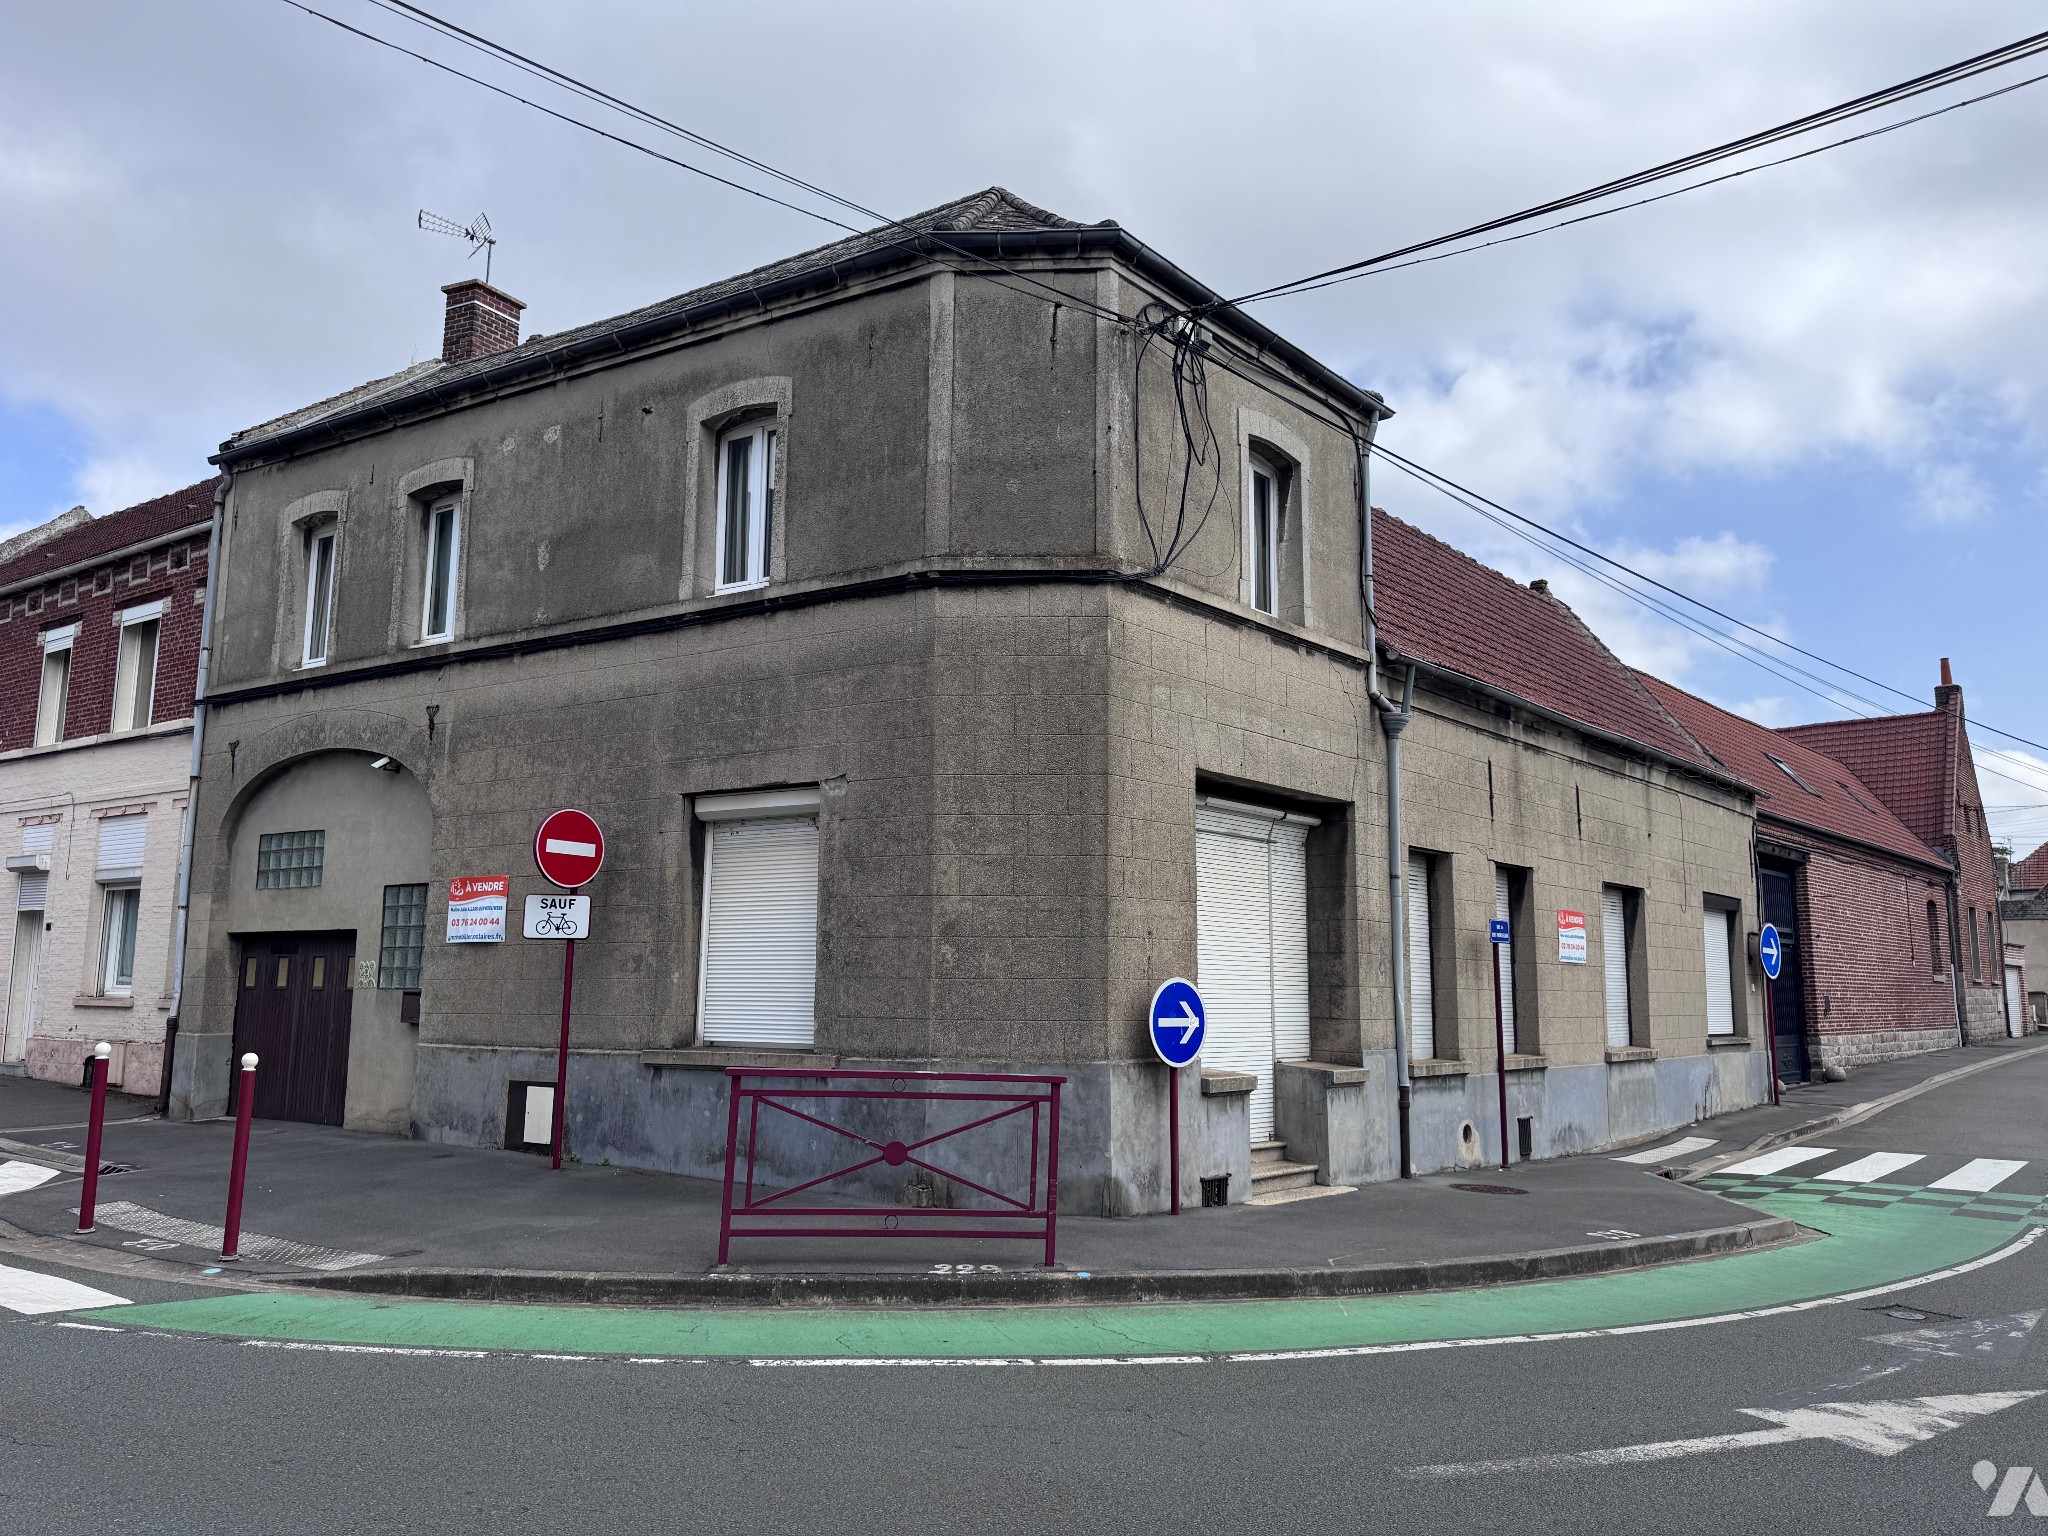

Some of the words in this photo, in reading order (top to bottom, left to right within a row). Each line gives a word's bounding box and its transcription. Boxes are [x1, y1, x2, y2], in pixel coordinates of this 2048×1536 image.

[465, 881, 472, 892] À
[473, 881, 504, 892] VENDRE
[540, 898, 577, 910] SAUF
[451, 918, 460, 927] 03
[461, 918, 469, 926] 76
[470, 918, 478, 926] 24
[479, 917, 488, 926] 00
[490, 917, 500, 926] 44
[927, 1263, 1003, 1274] 229
